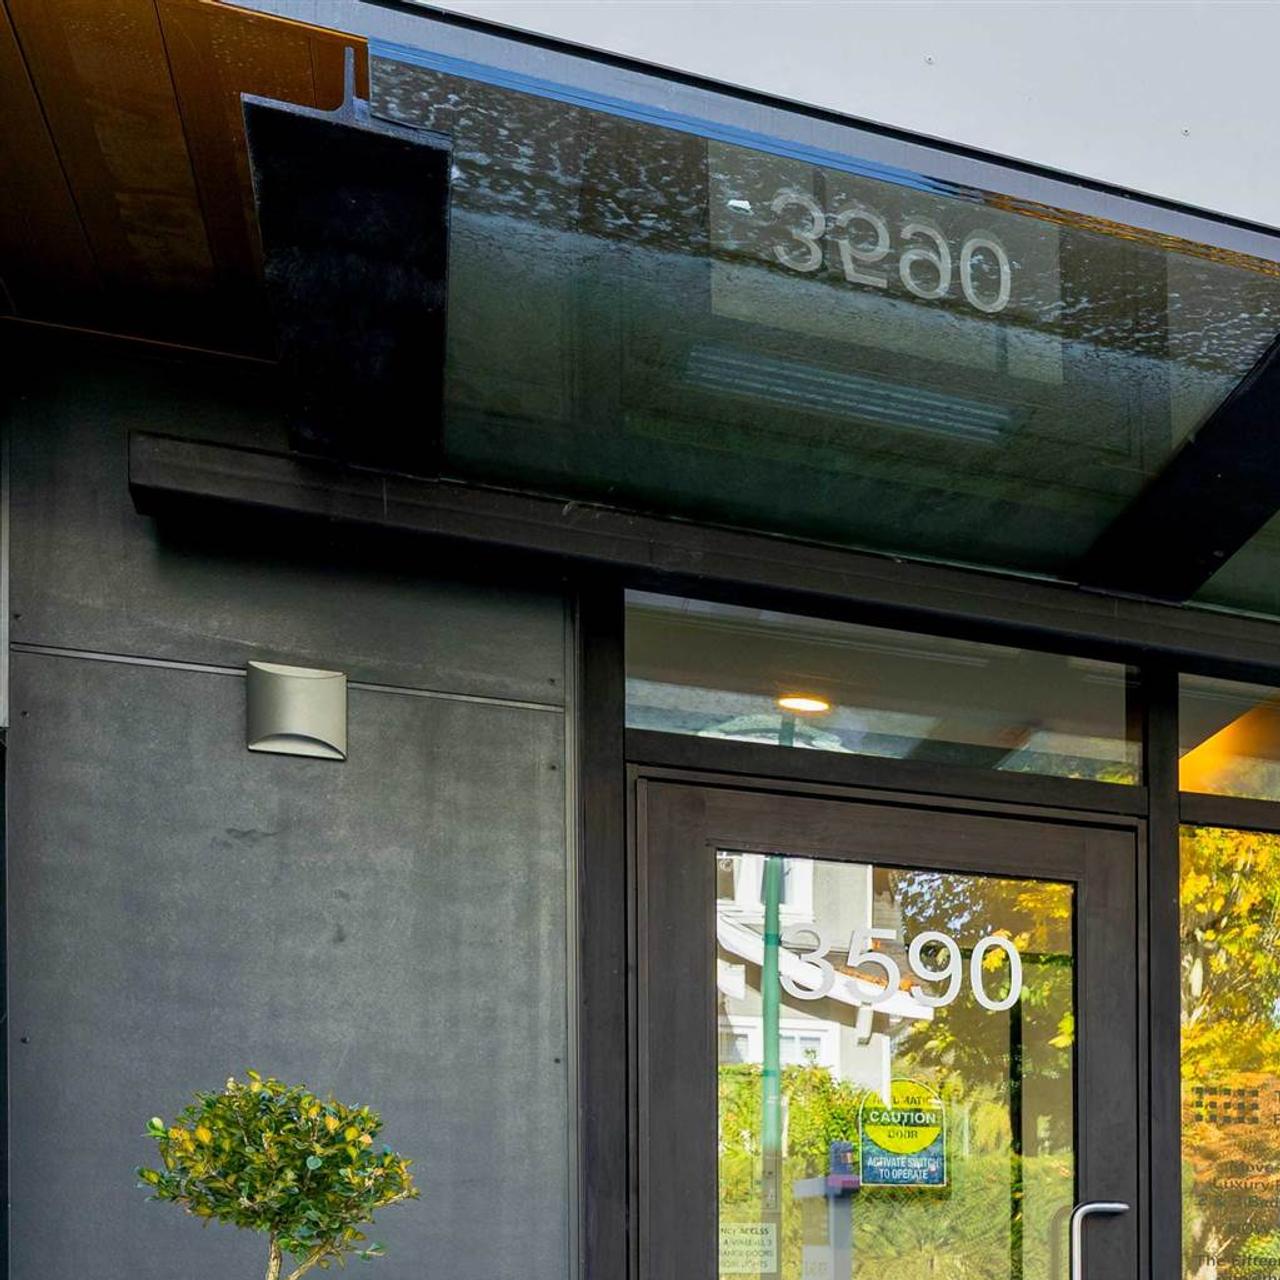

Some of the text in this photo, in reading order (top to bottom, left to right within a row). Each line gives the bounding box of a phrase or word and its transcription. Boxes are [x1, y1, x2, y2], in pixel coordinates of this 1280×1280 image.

[779, 923, 1022, 1011] 3590
[869, 1111, 936, 1124] CAUTION
[867, 1157, 906, 1168] ACTIVATE
[880, 1168, 928, 1179] TO OPERATE
